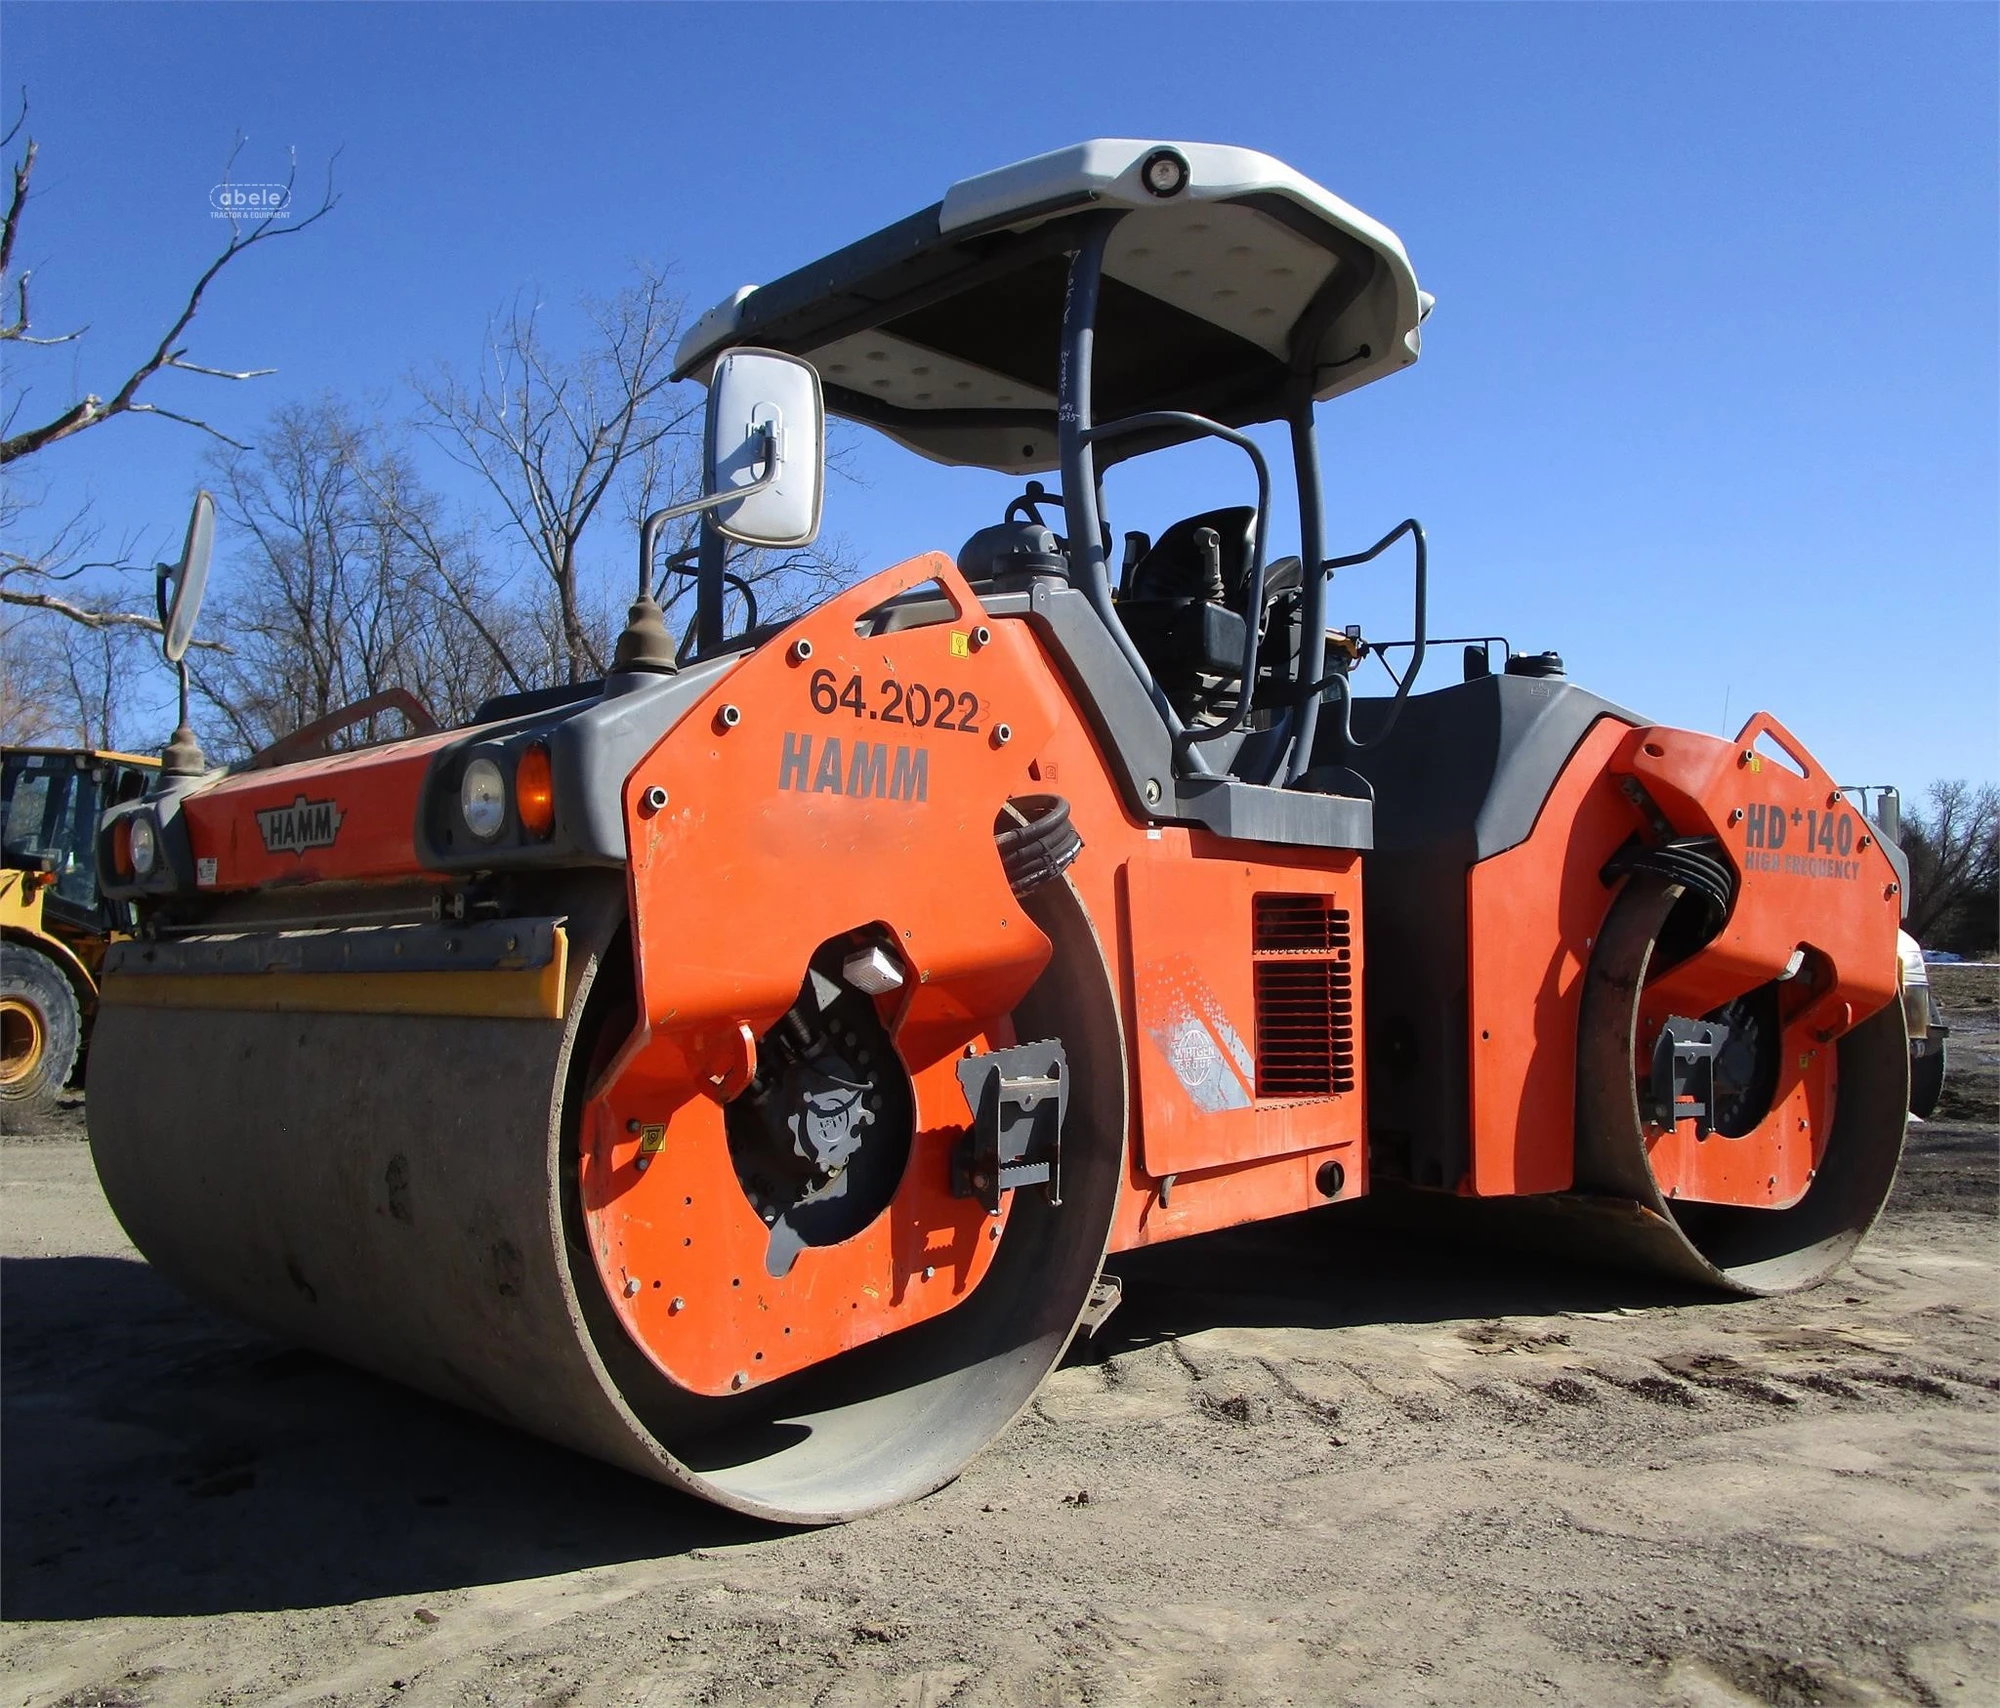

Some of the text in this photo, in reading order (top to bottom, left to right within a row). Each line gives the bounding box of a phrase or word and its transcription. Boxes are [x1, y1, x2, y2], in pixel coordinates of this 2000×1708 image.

[810, 668, 979, 734] 64.2022
[778, 731, 929, 802] HAMM
[270, 805, 332, 845] HAMM
[1745, 851, 1860, 880] HIGH FREQUENCY
[1174, 1046, 1215, 1071] WIRTGEN GROUP
